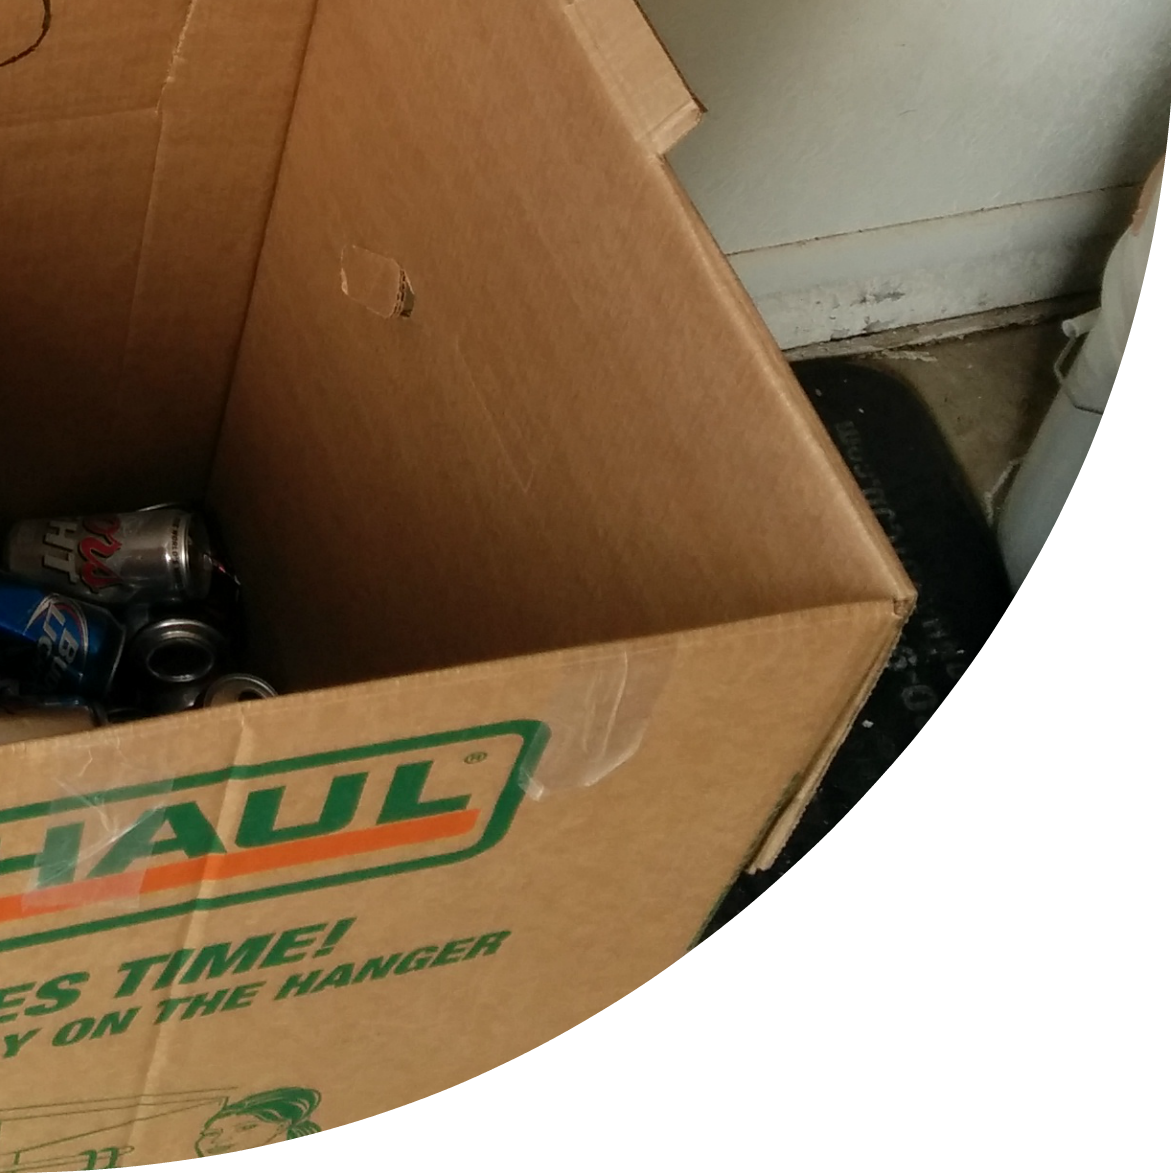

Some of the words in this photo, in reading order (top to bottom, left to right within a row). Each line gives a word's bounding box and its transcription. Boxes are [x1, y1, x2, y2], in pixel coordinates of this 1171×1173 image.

[50, 1006, 140, 1047] ON
[154, 980, 266, 1025] THE
[274, 929, 512, 1001] HANGER
[113, 916, 357, 999] TIME!
